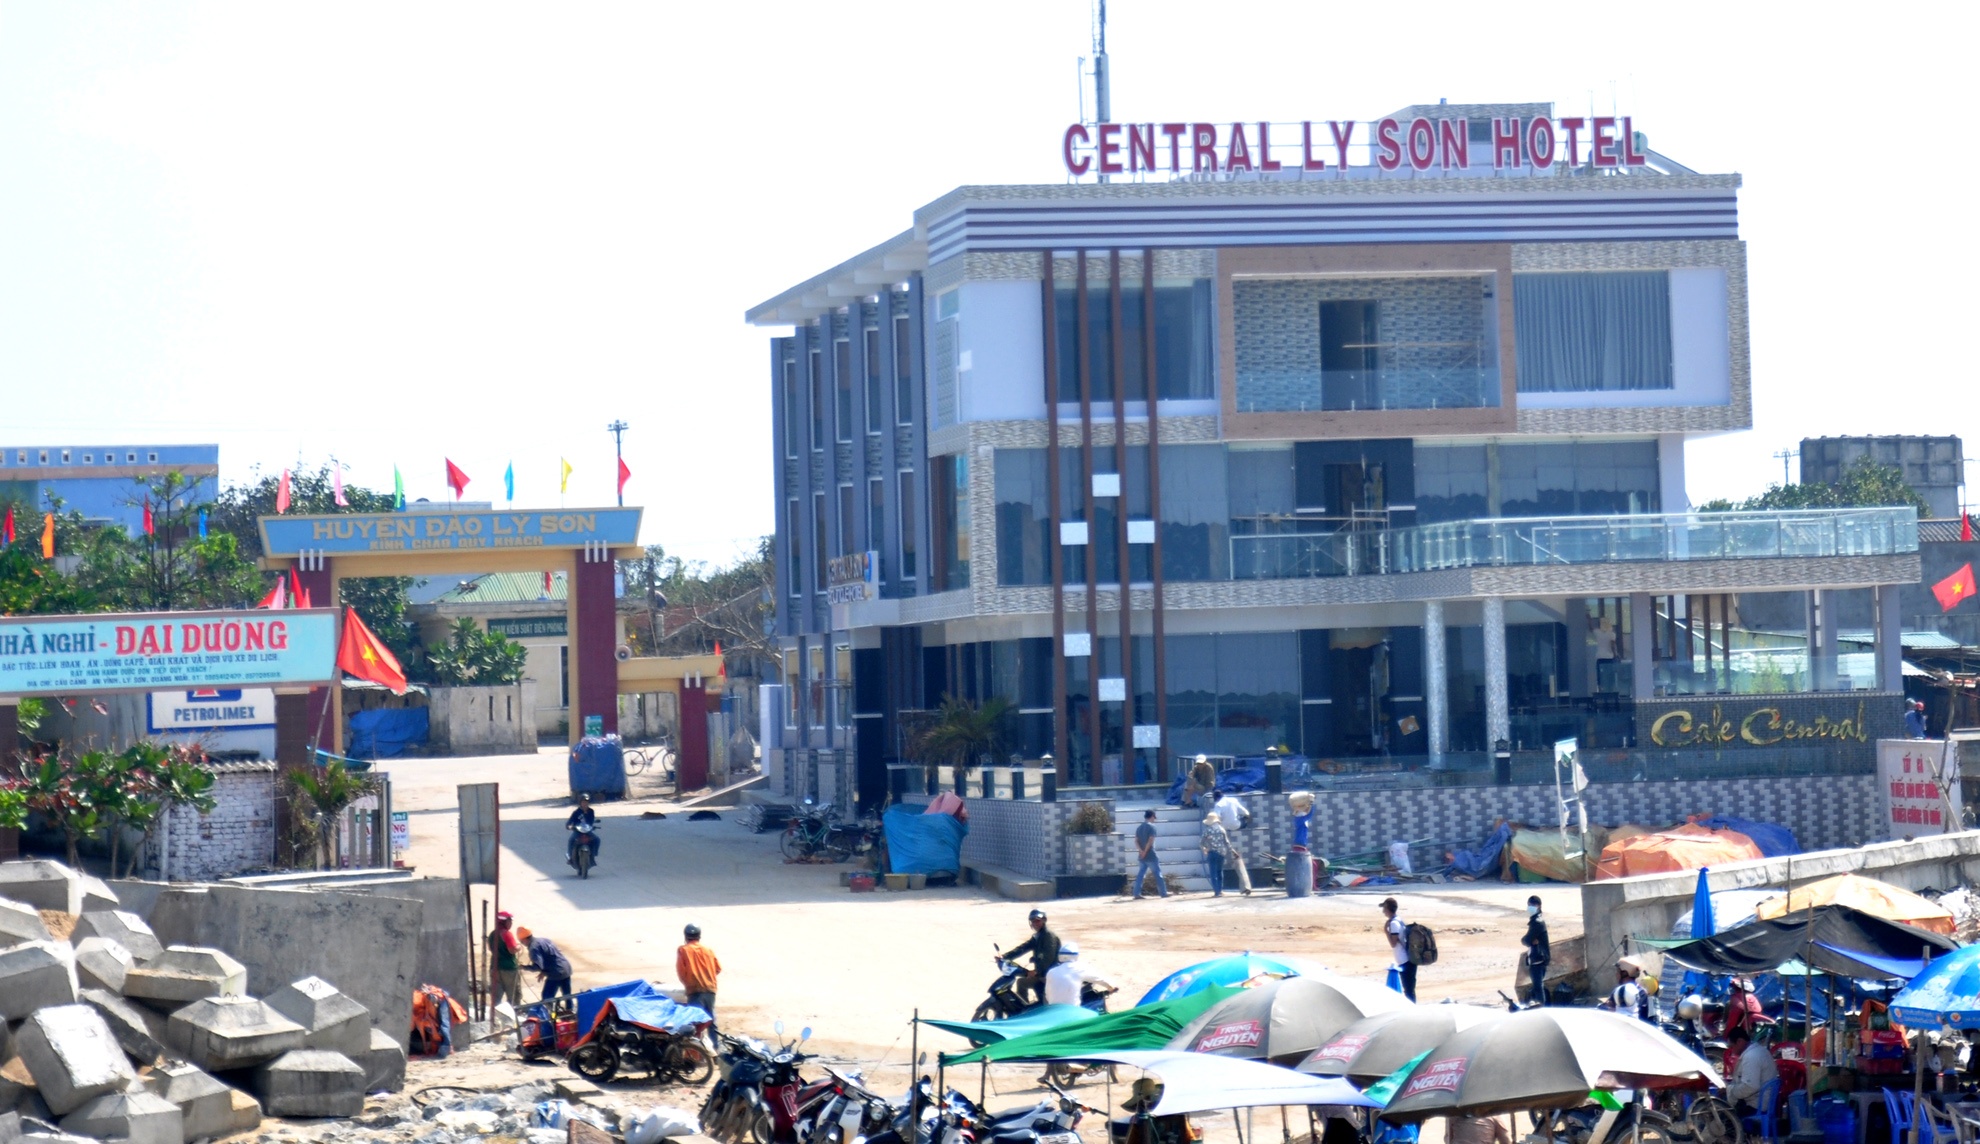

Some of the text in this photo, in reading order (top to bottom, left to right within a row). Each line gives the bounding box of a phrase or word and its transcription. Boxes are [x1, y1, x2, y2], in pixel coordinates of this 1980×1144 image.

[1064, 116, 1646, 176] CENTRAL LY SON HOTEL
[0, 627, 36, 655] HÀ
[182, 619, 287, 653] DƯƠNG
[174, 706, 255, 721] PETROLIMEX
[1741, 700, 1867, 745] Central
[1220, 1023, 1252, 1034] TRUNG
